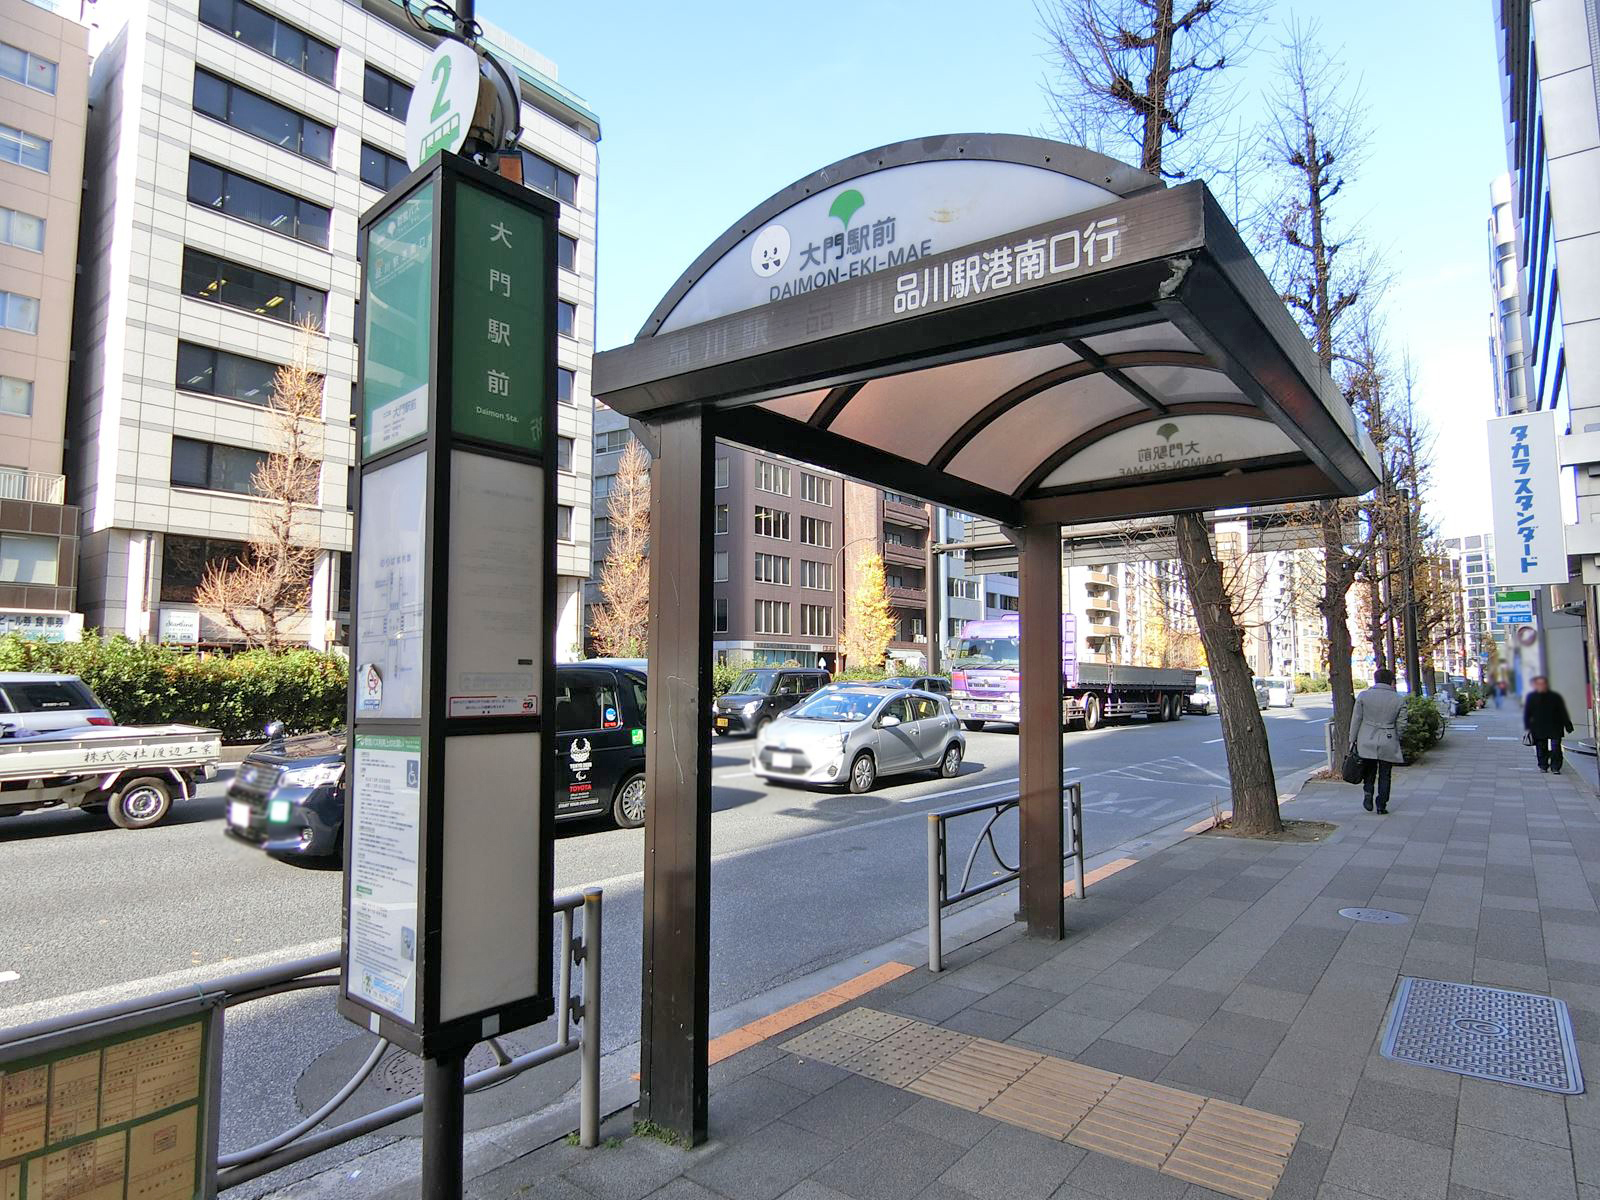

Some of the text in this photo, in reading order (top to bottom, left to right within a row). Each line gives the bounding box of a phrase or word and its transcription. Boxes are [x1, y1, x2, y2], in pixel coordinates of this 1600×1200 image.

[429, 54, 451, 123] 2
[769, 238, 932, 302] DAIMON-EKI-MAE
[799, 216, 896, 272] 大門駅前
[893, 216, 1121, 314] 品川駅港南口行
[487, 221, 513, 397] 大門駅前
[476, 406, 504, 420] Daimon
[1510, 424, 1538, 574] タカラスタンダード
[569, 784, 592, 793] TOYOTA
